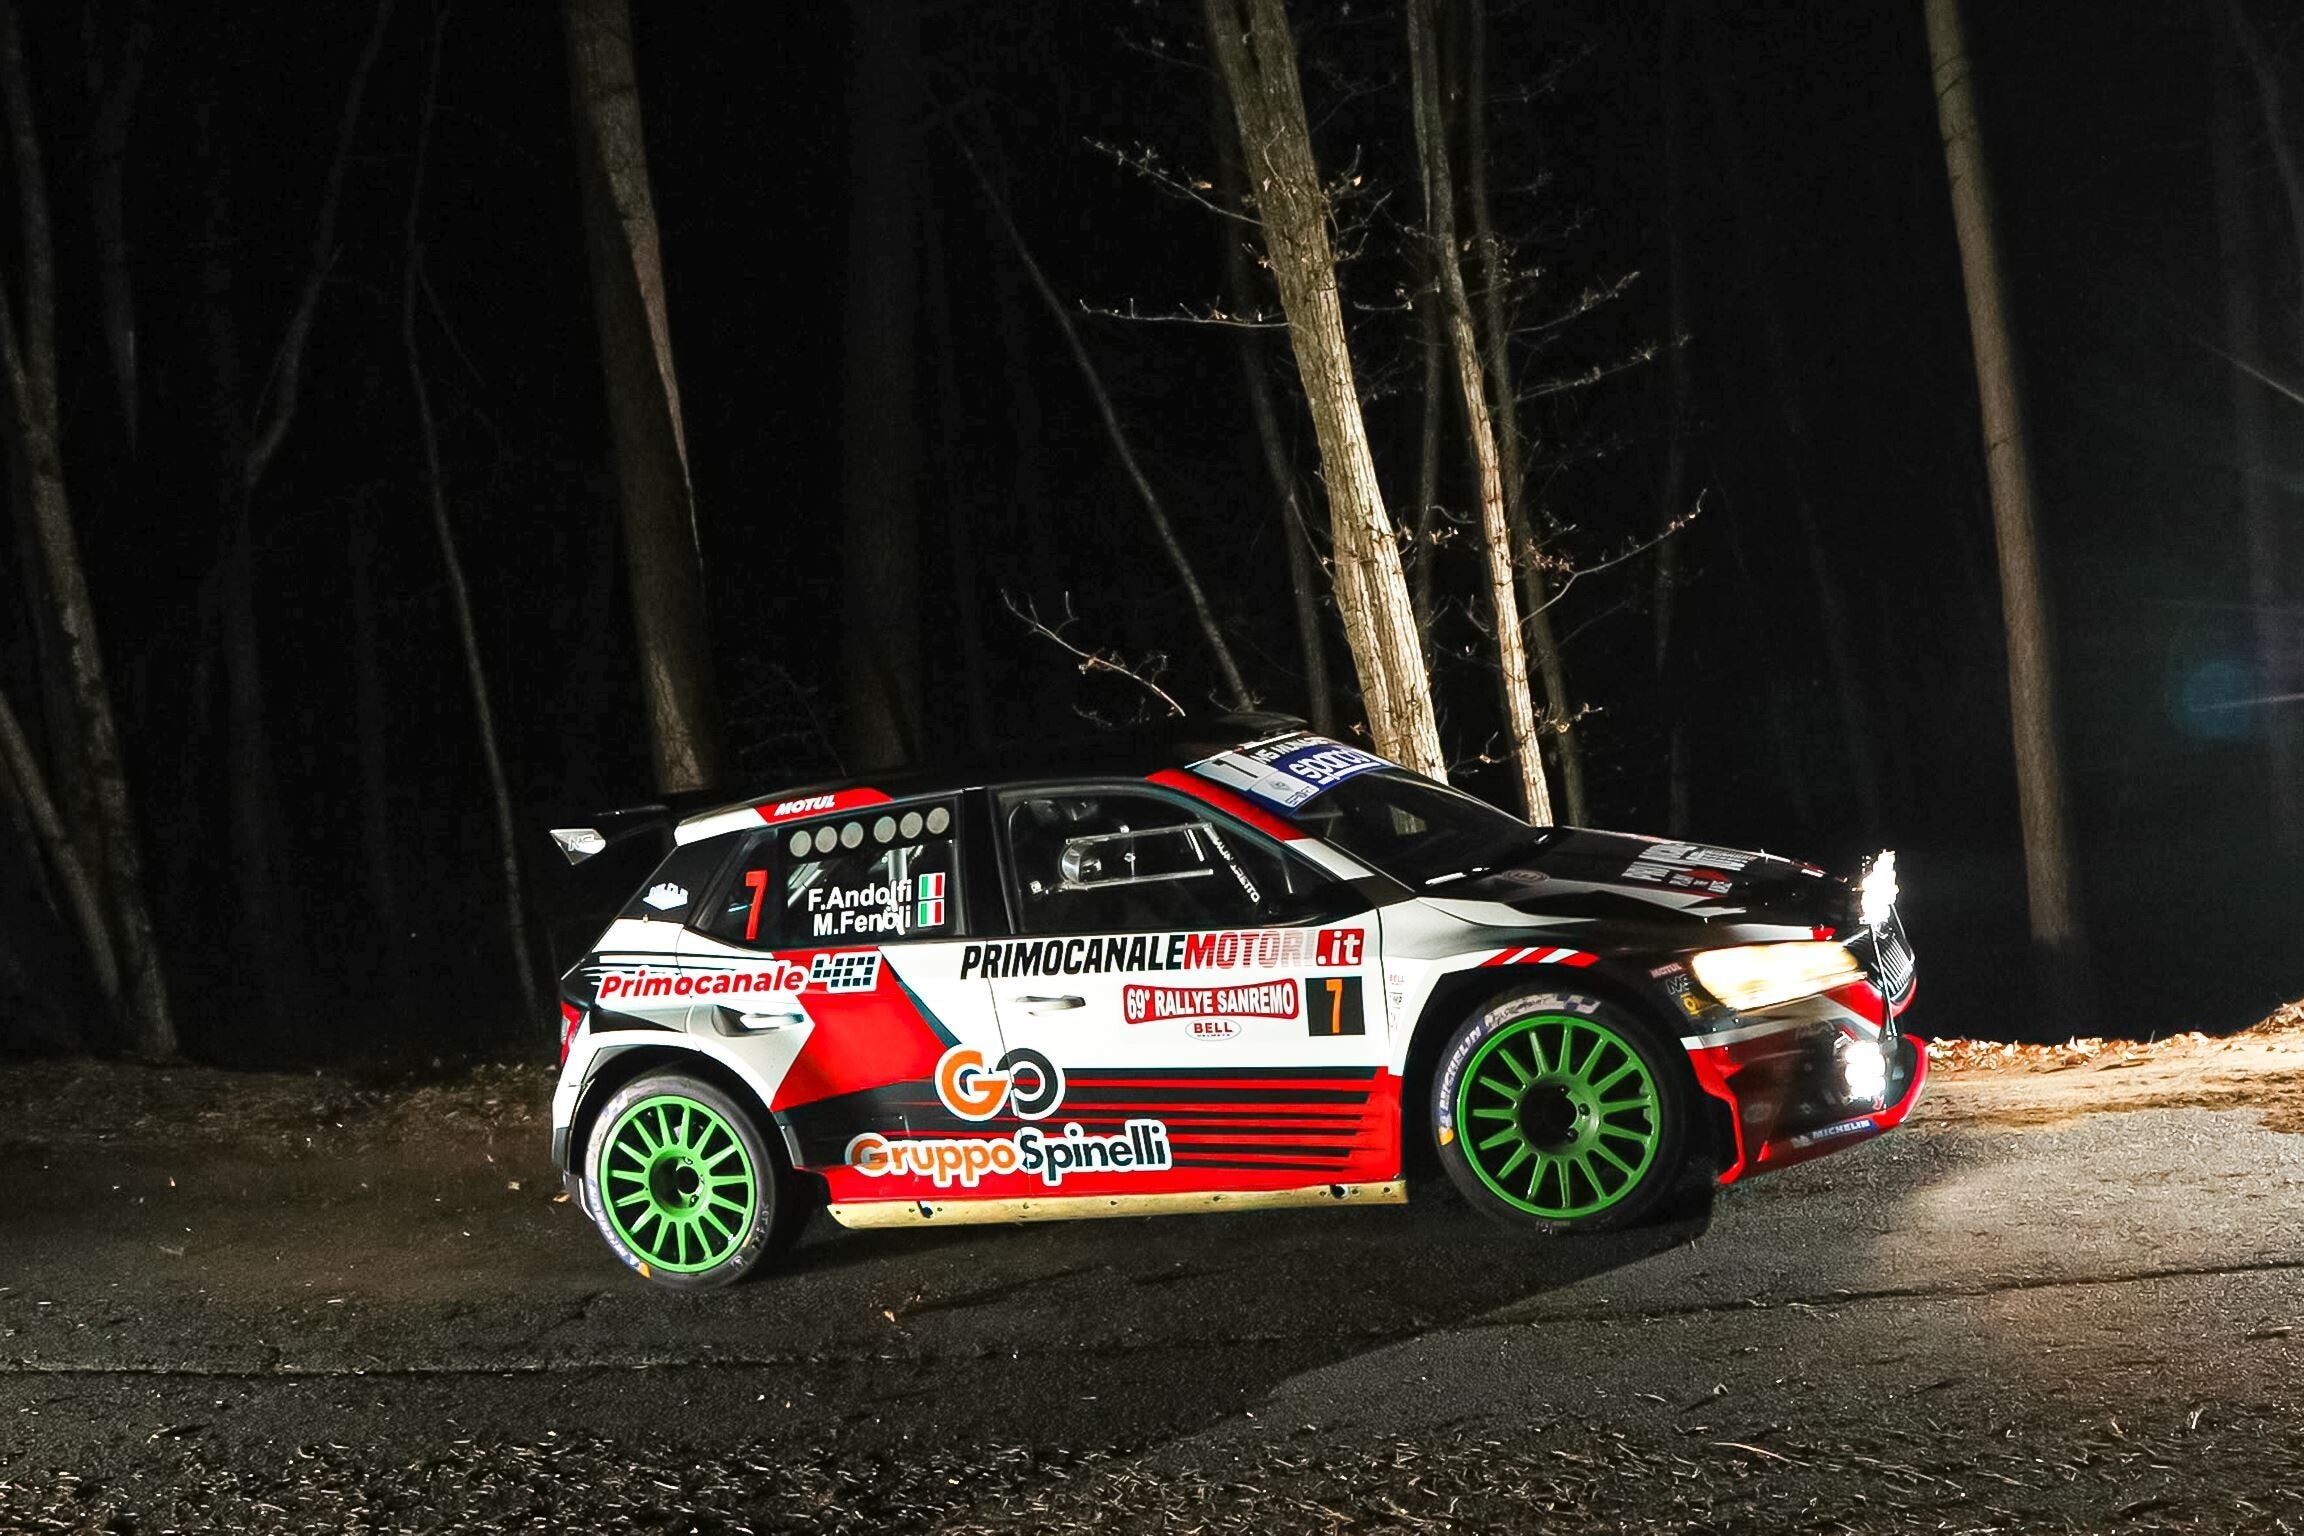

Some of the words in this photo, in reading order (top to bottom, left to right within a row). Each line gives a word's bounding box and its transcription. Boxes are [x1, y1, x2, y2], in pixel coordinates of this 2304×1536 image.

[774, 795, 836, 816] MOTUL
[745, 869, 769, 941] 7
[808, 879, 912, 912] F.Andolfi
[600, 966, 805, 999] Primocanale
[1154, 989, 1213, 1015] RALLYE
[1216, 981, 1295, 1015] SANREMO
[1326, 978, 1343, 1034] 7
[1194, 1022, 1233, 1034] BELL
[1439, 1026, 1482, 1111] MICHELIN
[1812, 1119, 1871, 1139] MICHELIN
[850, 1138, 1017, 1182] Gruppo
[1019, 1126, 1168, 1182] Spinelli
